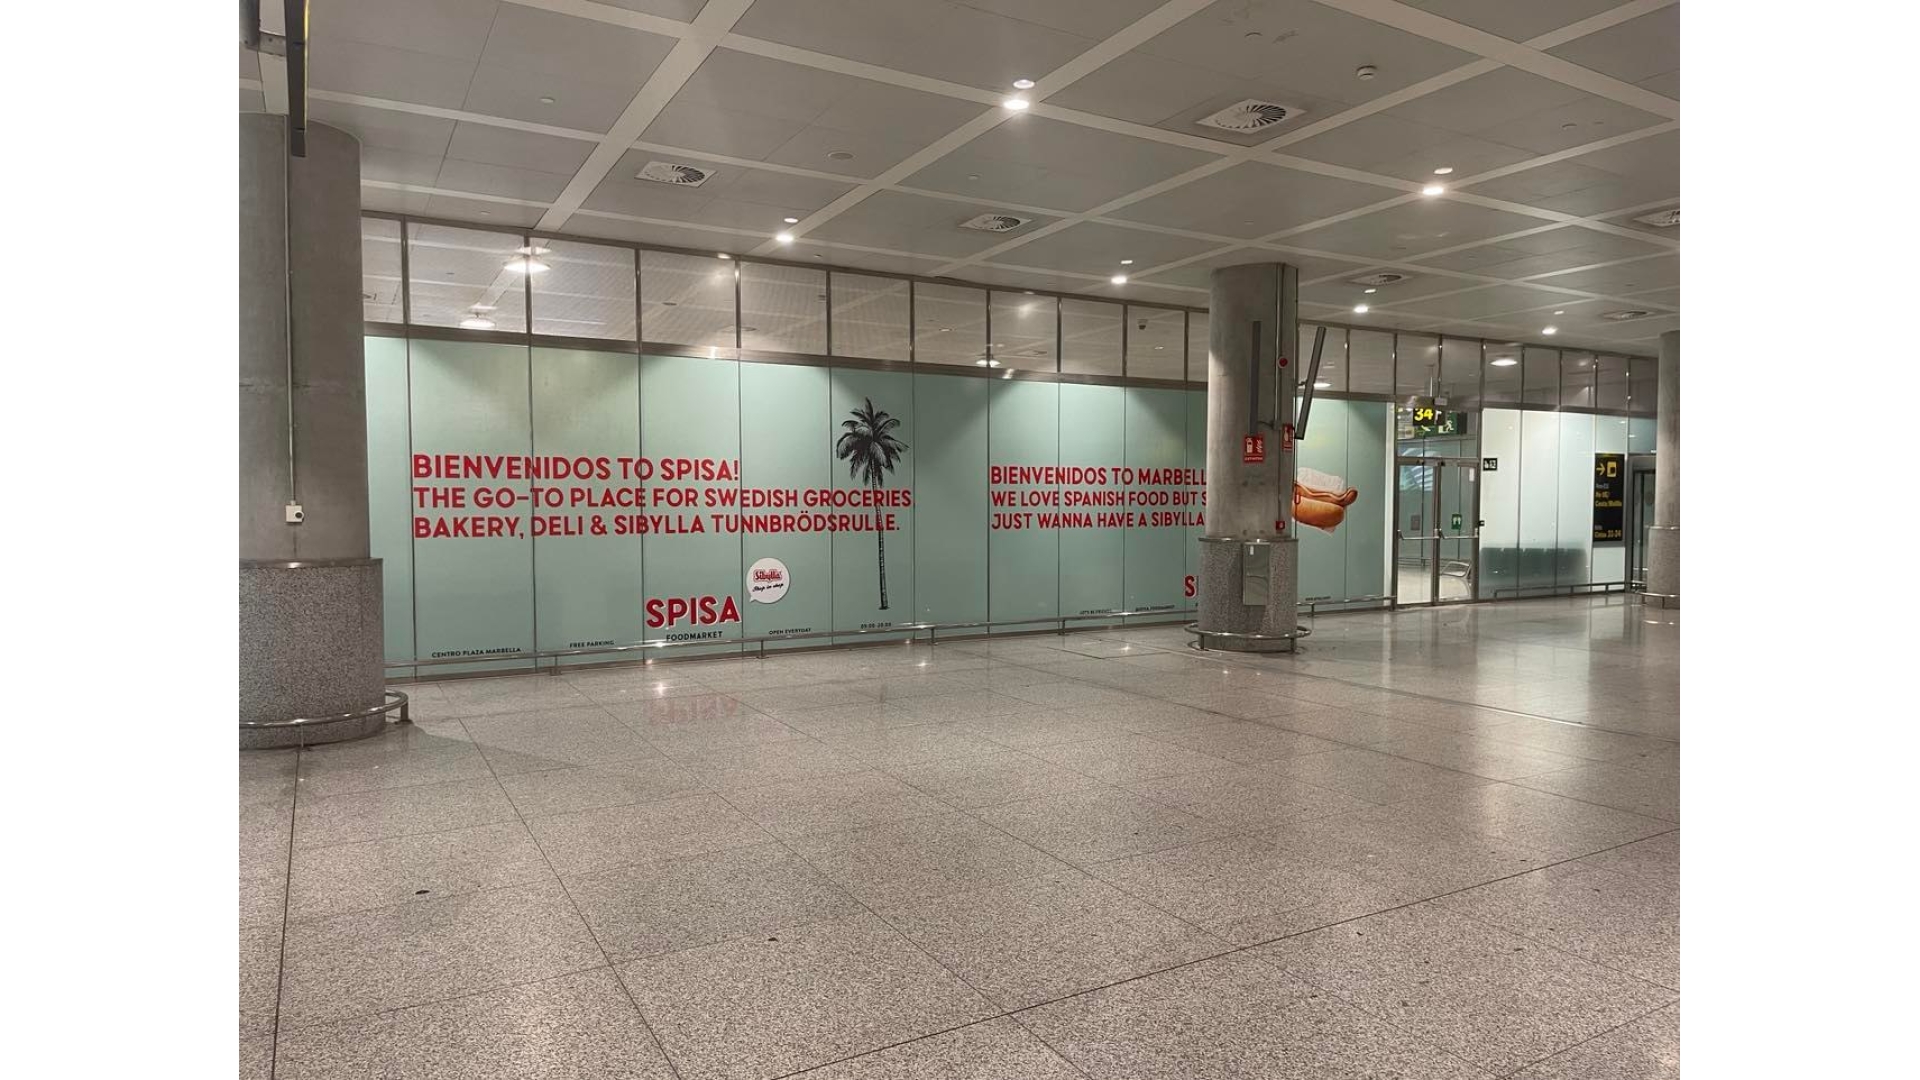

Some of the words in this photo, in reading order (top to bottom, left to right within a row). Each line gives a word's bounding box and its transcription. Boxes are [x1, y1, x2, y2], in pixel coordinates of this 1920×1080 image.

[1414, 408, 1434, 421] 34
[413, 454, 612, 480] BIENVENIDOS
[617, 457, 654, 480] TO
[660, 458, 739, 481] SPISA!
[990, 466, 1107, 485] BIENVENIDOS
[1112, 467, 1134, 485] TO
[414, 487, 466, 508] THE
[570, 487, 646, 507] PLACE
[653, 487, 699, 507] FOR
[704, 488, 799, 507] SWEDISH
[803, 489, 912, 507] GROCERIES
[991, 491, 1016, 507] WE
[1020, 491, 1060, 507] LOVE
[1064, 491, 1126, 507] SPANISH
[1128, 491, 1169, 506] FOOD
[1172, 491, 1198, 506] BUT
[414, 516, 524, 539] BAKERY,
[531, 515, 583, 537] DELI
[590, 515, 607, 535] &
[614, 514, 705, 535] SIBYLLA
[711, 510, 900, 533] TUNNBRÖDSRULLE.
[991, 513, 1032, 530] JUST
[1037, 513, 1093, 529] WANNA
[1097, 512, 1134, 528] HAVE
[1138, 512, 1148, 527] A
[1151, 511, 1205, 527] SIBYLLA
[1185, 575, 1198, 597] S
[645, 595, 742, 629] SPISA
[586, 640, 615, 648] PARKING
[666, 631, 723, 641] FOODMARKET
[431, 650, 461, 658] CENTRO
[463, 649, 484, 657] PLAZA
[485, 647, 521, 655] MARBELLA
